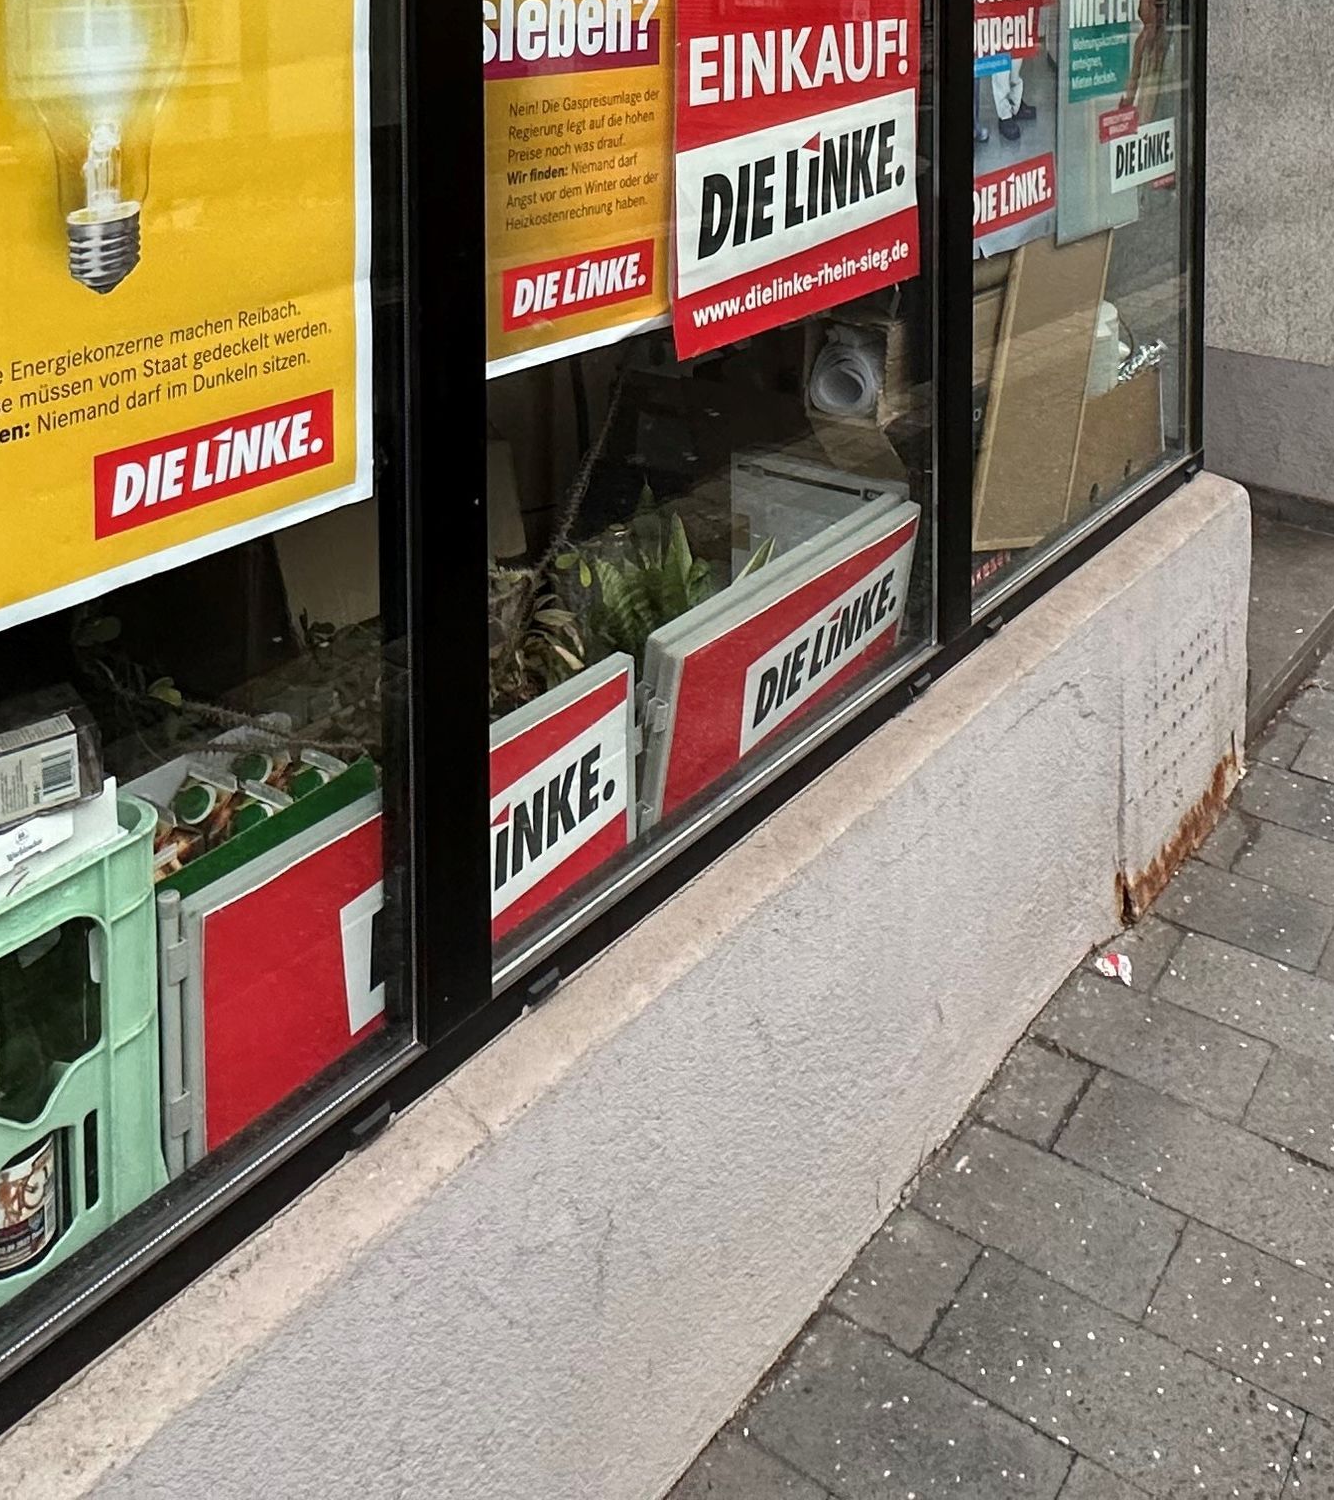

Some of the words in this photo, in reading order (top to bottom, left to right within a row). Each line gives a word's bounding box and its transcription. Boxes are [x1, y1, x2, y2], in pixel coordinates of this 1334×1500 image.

[689, 18, 908, 107] EINKAUF!
[508, 122, 564, 142] Regierung
[567, 118, 586, 135] legt
[589, 114, 605, 129] auf
[607, 113, 623, 126] die
[625, 110, 655, 124] hohen
[509, 101, 538, 117] Nein!
[542, 99, 560, 114] Die
[563, 91, 642, 113] Gaspreisumlage
[644, 88, 660, 101] der
[507, 170, 527, 185] Wir
[529, 166, 569, 182] finden:
[571, 157, 616, 175] Niemand
[618, 152, 638, 167] darf
[508, 147, 543, 163] Preise
[545, 141, 571, 157] noch
[574, 140, 595, 153] was
[597, 133, 626, 150] drauf.
[1115, 140, 1135, 180] DIE
[1137, 130, 1174, 171] LINKE.
[505, 200, 613, 232] Heizkostenrechnung
[615, 194, 648, 210] haben.
[506, 193, 537, 210] Angst
[540, 190, 557, 203] vor
[559, 185, 582, 199] dem
[585, 179, 618, 195] Winter
[619, 174, 641, 188] oder
[643, 171, 659, 185] der
[697, 154, 776, 261] DIE
[784, 119, 905, 230] LINKE.
[999, 166, 1051, 223] LINKE.
[511, 270, 561, 319] DIE
[562, 253, 647, 303] LINKE.
[693, 238, 909, 329] www.dielinke-rhein-sieg.de
[11, 333, 164, 381] Energiekonzerne
[170, 318, 233, 345] machen
[238, 301, 301, 328] Reibach.
[20, 378, 93, 409] müssen
[99, 367, 137, 388] vom
[143, 351, 188, 378] Staat
[193, 333, 269, 370] gedeckelt
[274, 320, 332, 346] werden.
[37, 394, 120, 434] Niemand
[126, 384, 162, 410] darf
[167, 381, 188, 400] im
[193, 363, 258, 393] Dunkeln
[263, 352, 311, 375] sitzen.
[111, 445, 188, 518] DIE
[191, 409, 324, 491] LINKE.
[753, 637, 811, 730] DIE
[808, 569, 897, 682] LINKE.
